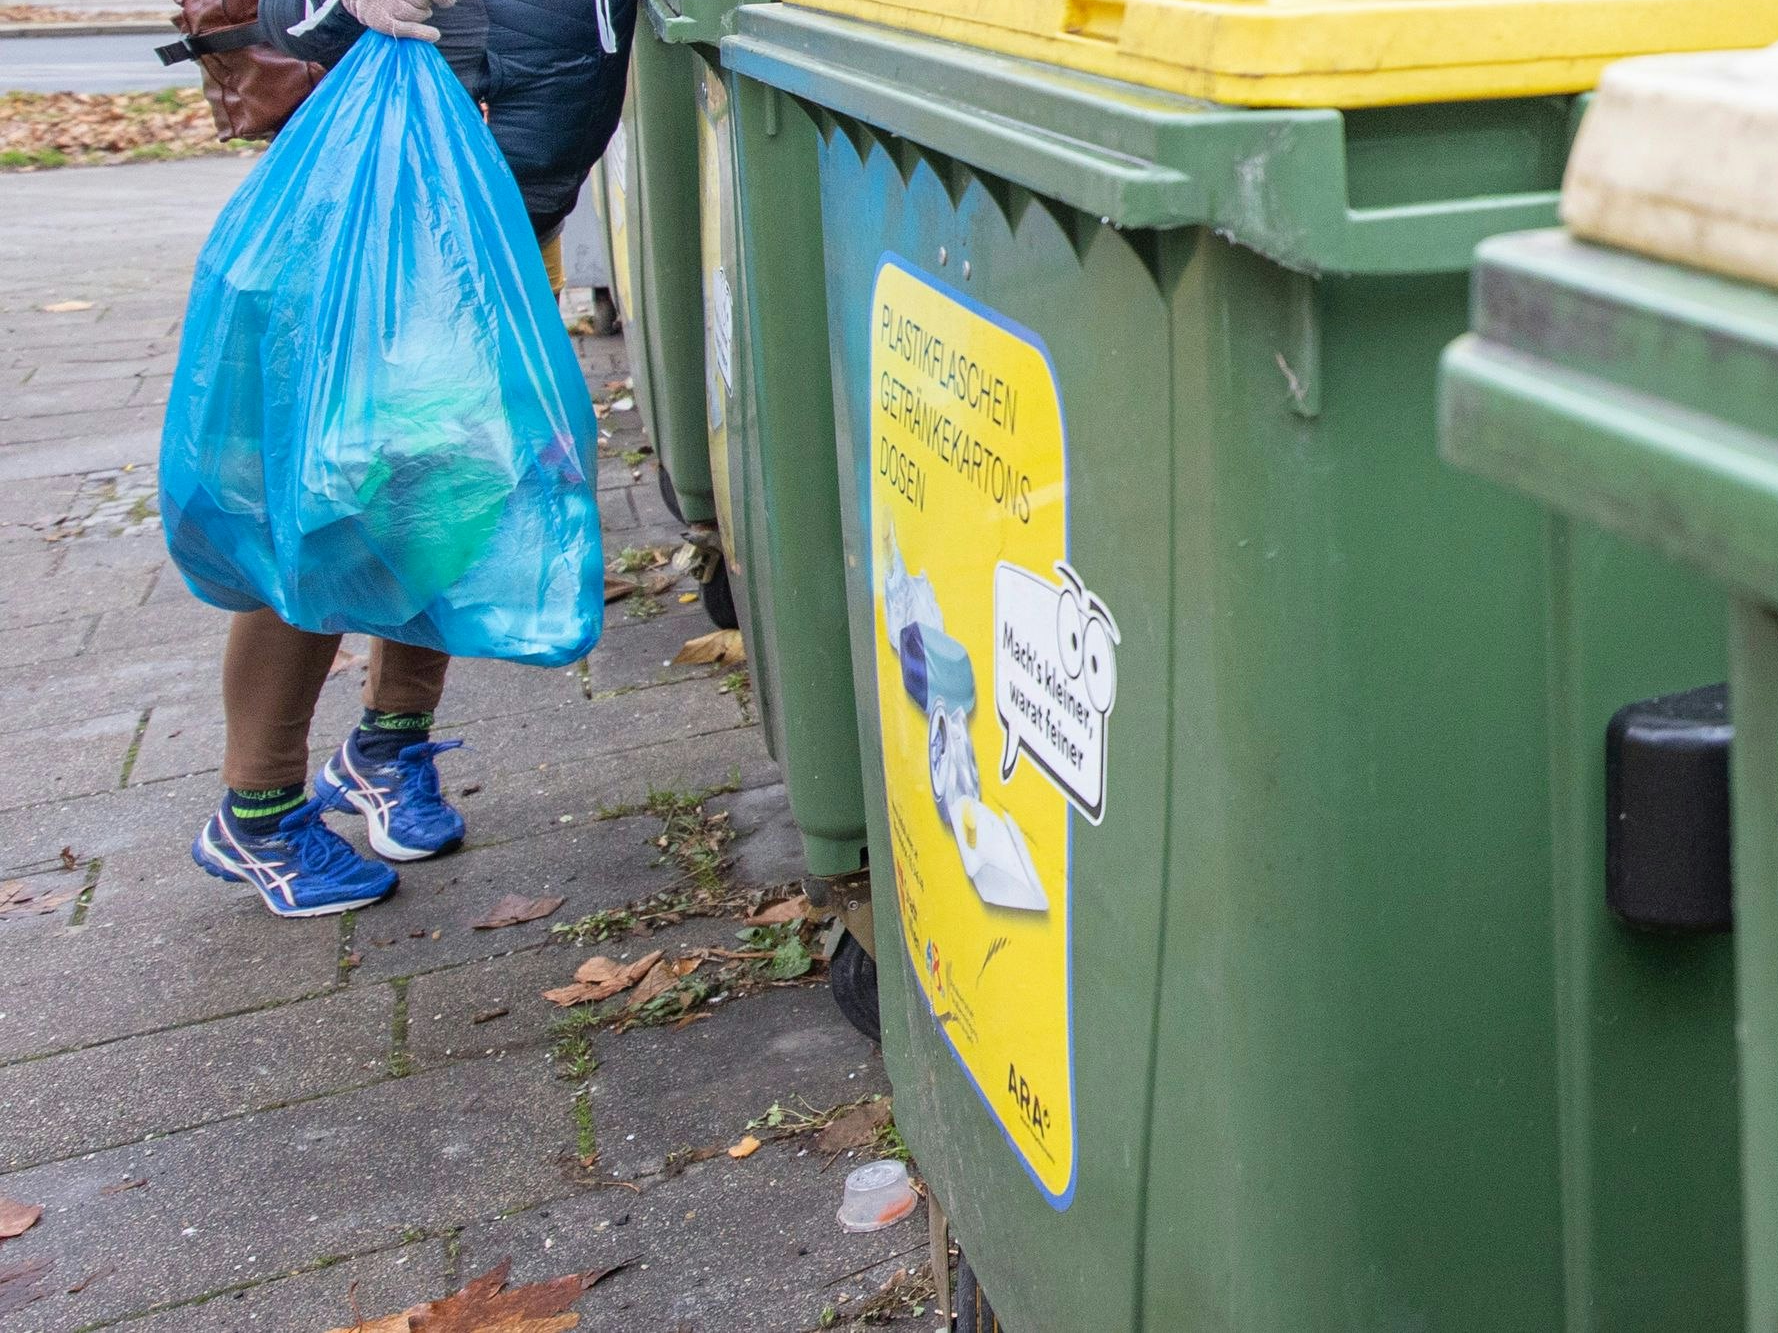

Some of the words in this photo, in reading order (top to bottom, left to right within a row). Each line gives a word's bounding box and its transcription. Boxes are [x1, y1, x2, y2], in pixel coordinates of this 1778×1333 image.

[881, 304, 1018, 436] PLASTIKFLASCHEN
[880, 370, 1031, 524] GETRÄNKEKARTONS
[880, 436, 926, 513] DOSEN
[1002, 620, 1043, 684] Mach's
[1044, 660, 1093, 740] kleiner,
[1009, 681, 1044, 729] warat
[1046, 710, 1084, 772] feiner
[1008, 1062, 1045, 1139] ARA
